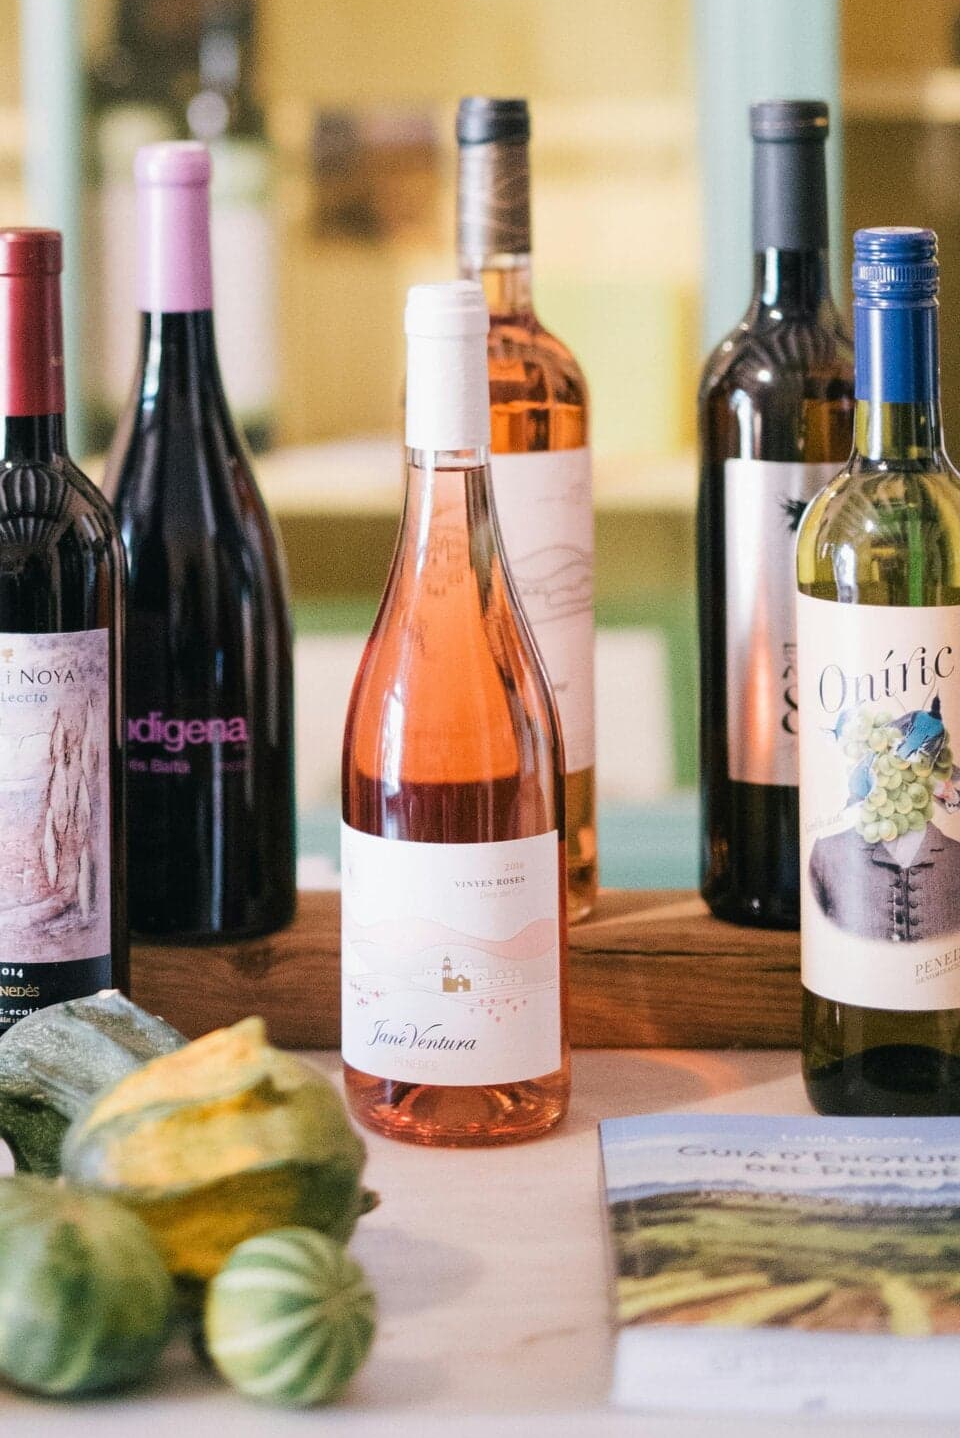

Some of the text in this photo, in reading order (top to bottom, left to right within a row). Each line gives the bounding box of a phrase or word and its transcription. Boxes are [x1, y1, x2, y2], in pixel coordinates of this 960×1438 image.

[20, 669, 75, 684] NOYA
[820, 646, 955, 713] Oníric
[496, 875, 526, 887] ROSES
[404, 1022, 479, 1051] Ventura
